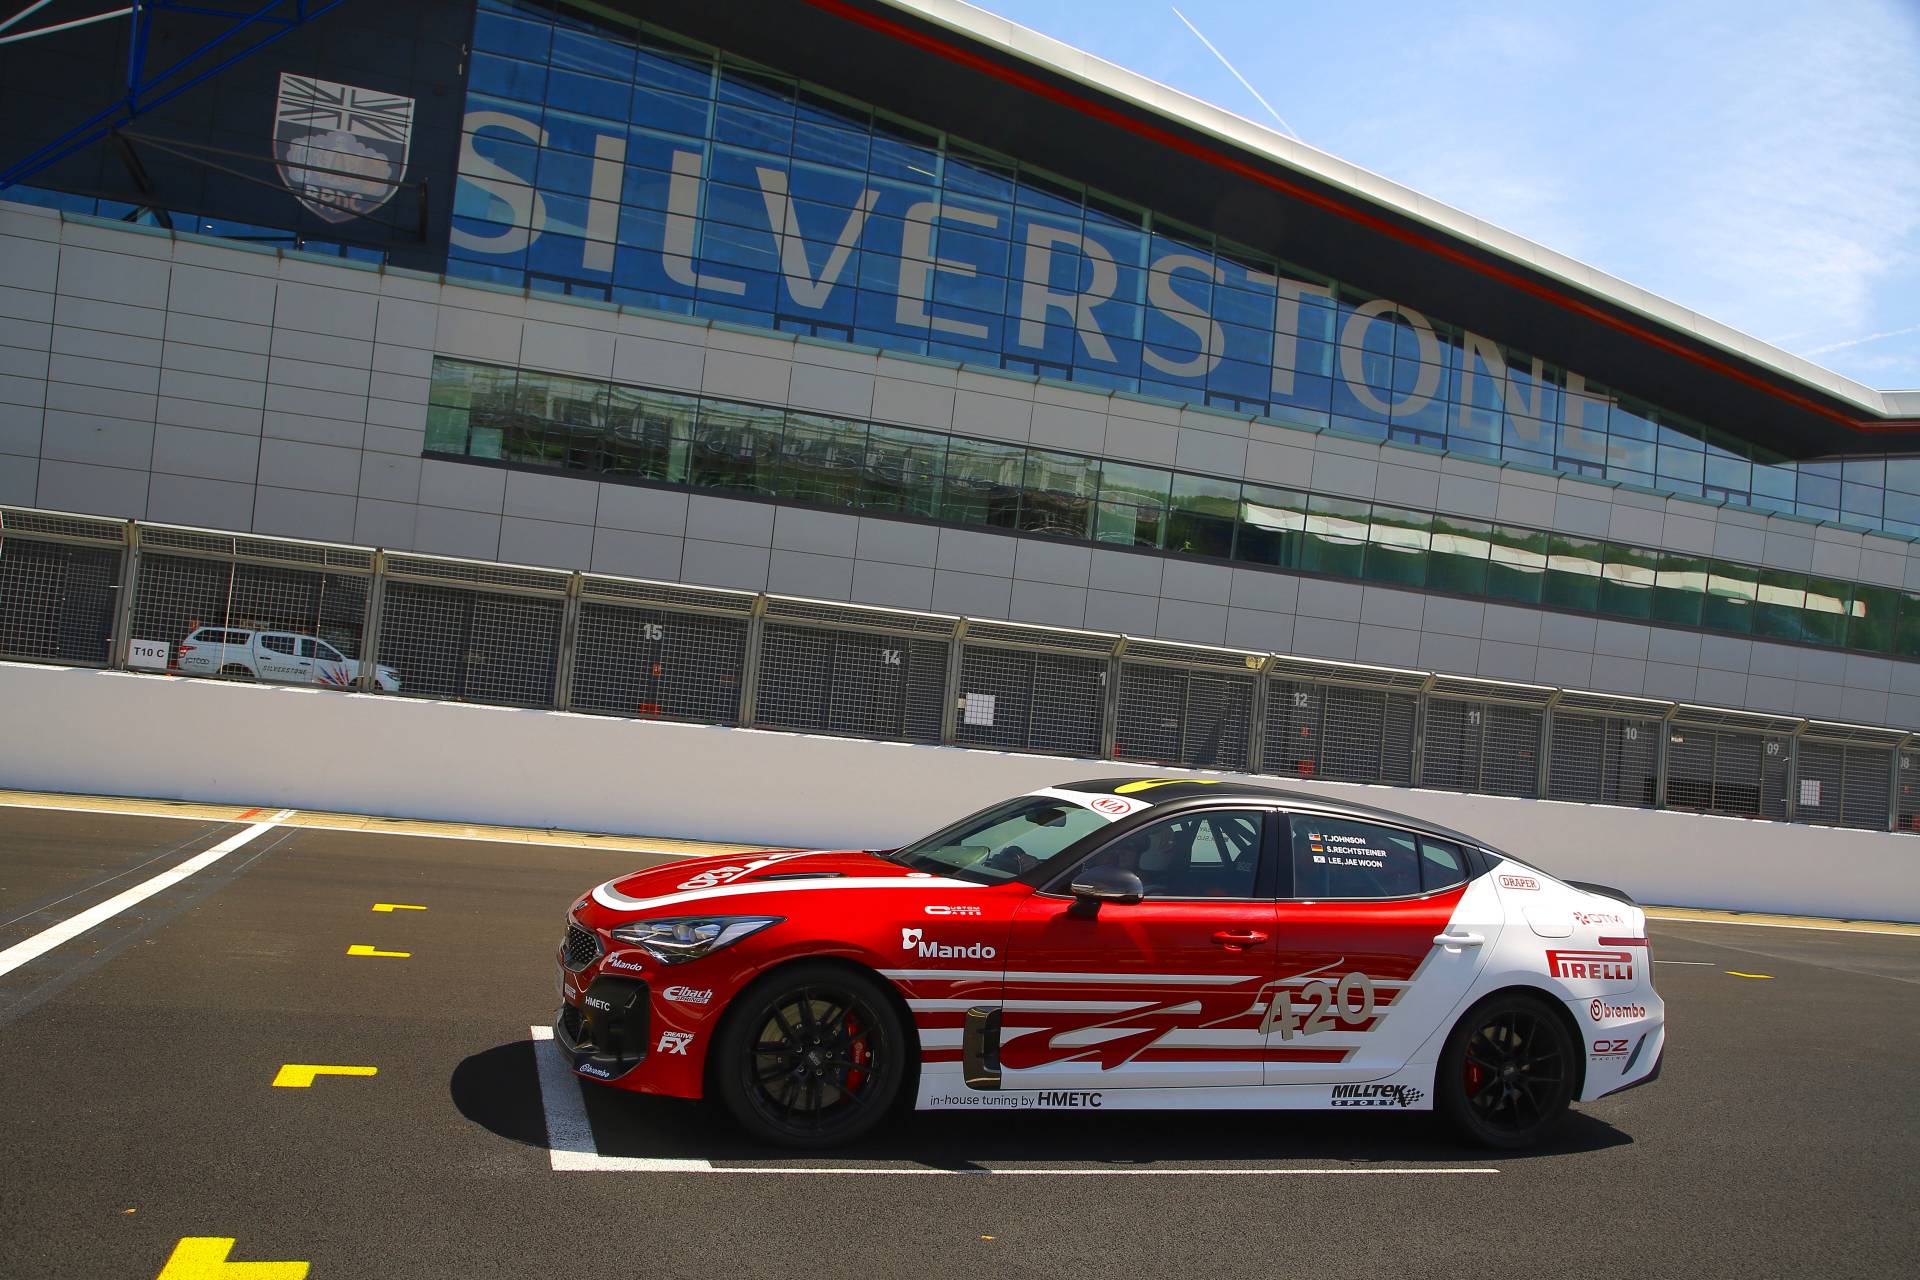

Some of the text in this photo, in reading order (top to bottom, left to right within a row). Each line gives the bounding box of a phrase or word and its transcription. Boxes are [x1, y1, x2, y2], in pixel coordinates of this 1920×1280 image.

[449, 111, 1626, 458] SILVERSTONE
[644, 624, 662, 640] 15
[133, 646, 165, 658] T10 C
[882, 650, 901, 665] 14
[263, 664, 307, 675] SILVERSTONE
[1099, 671, 1107, 686] 1
[1294, 692, 1308, 708] 12
[1468, 711, 1481, 725] 11
[1625, 727, 1638, 740] 10
[1767, 742, 1780, 755] 09
[1098, 799, 1121, 813] KIA
[1358, 860, 1383, 868] WOON
[1503, 877, 1537, 889] DRAPER
[918, 942, 996, 959] Mando
[611, 960, 643, 971] Mando
[1545, 950, 1633, 980] PIRELLI
[662, 985, 713, 1003] Eibach
[585, 996, 610, 1011] HMETC
[1258, 972, 1374, 1041] 420
[1603, 1003, 1646, 1018] brembo
[663, 1031, 695, 1040] CREATIVE
[656, 1036, 692, 1056] FX
[589, 1065, 610, 1078] brembo
[930, 1091, 1102, 1108] in-house tuning by HMETC
